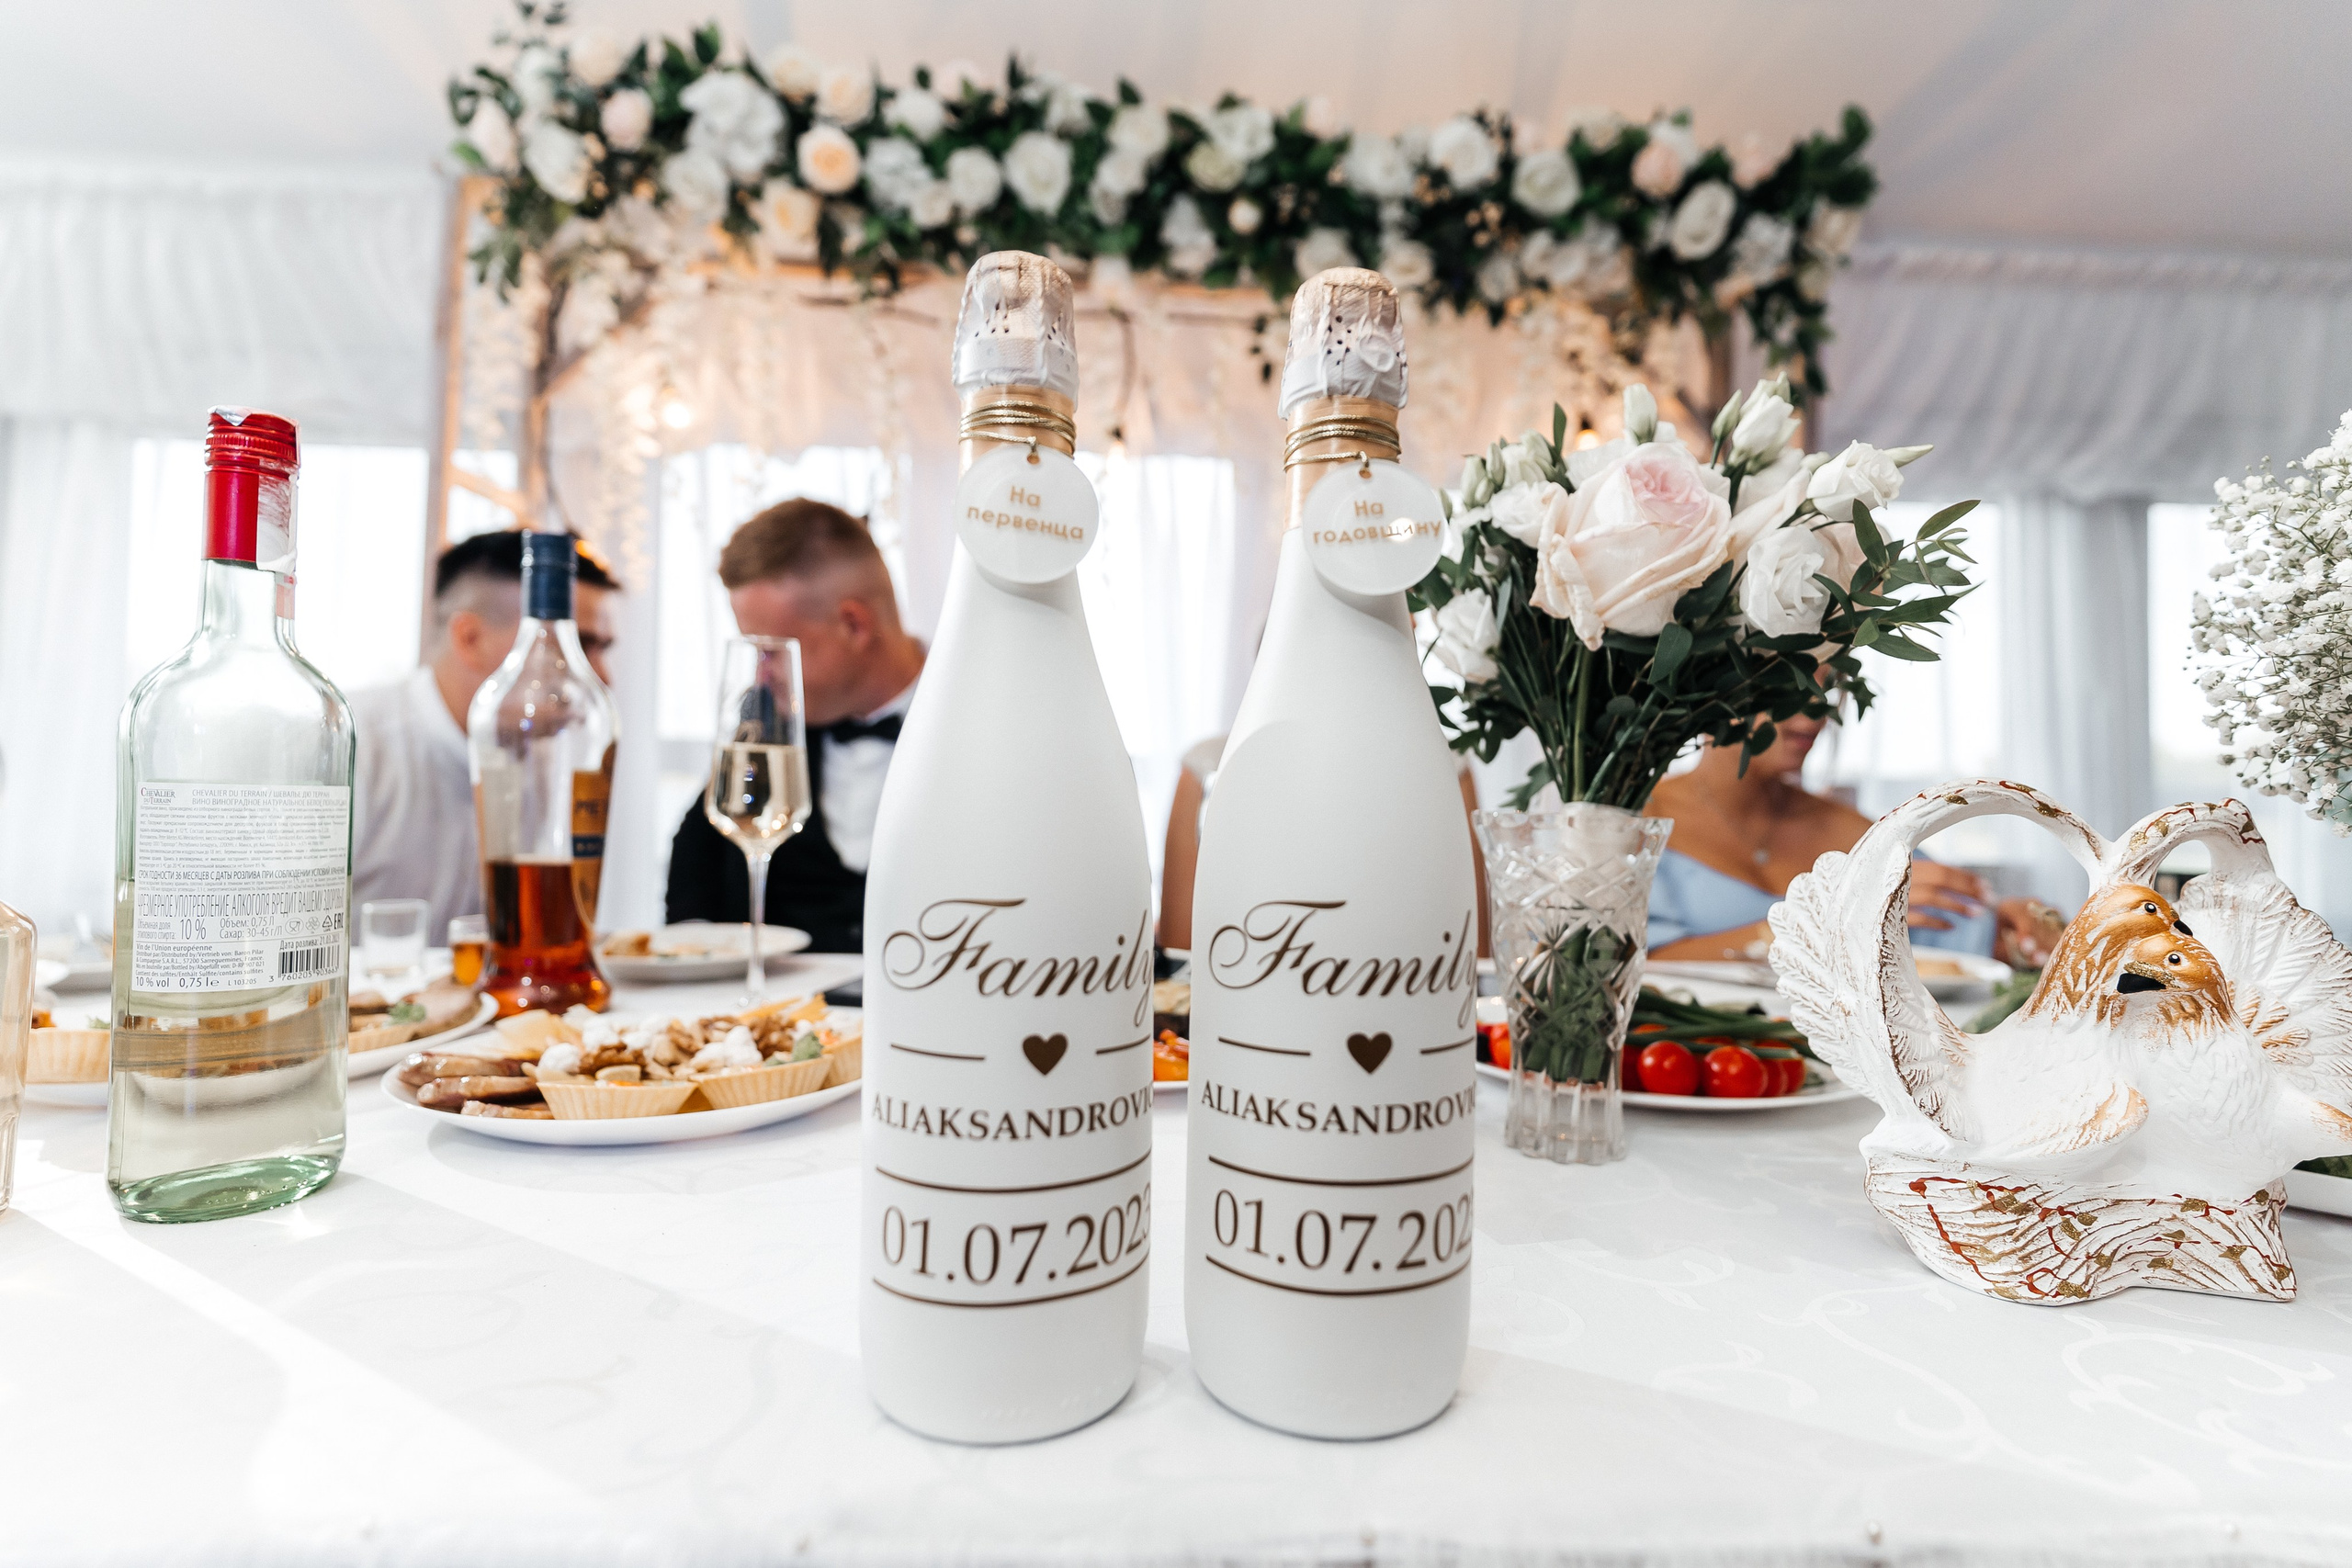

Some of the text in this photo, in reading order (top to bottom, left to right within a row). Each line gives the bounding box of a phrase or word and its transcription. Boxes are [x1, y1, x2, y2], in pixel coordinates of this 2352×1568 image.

[1010, 485, 1042, 507] На
[1354, 500, 1385, 517] На
[967, 505, 1085, 541] первенца
[1313, 520, 1443, 545] годовщину
[241, 790, 267, 798] TERRAIN
[212, 798, 261, 807] ВИНОГРАДНОЕ
[263, 798, 305, 807] НАТУРАЛЬНОЕ
[149, 870, 175, 880] ГОДНОСТИ
[175, 871, 182, 879] 36
[183, 871, 209, 881] МЕСЯЦЕВ
[210, 871, 215, 879] С
[216, 871, 232, 881] ДАТЫ
[233, 871, 261, 880] РОЗЛИВА
[262, 870, 274, 879] ПРИ
[275, 869, 311, 878] СОБЛЮДЕНИИ
[175, 894, 230, 918] УПОТРЕБЛЕНИЕ
[232, 894, 270, 917] АЛКОГОЛЯ
[272, 892, 298, 917] ВРЕДИТ
[299, 890, 322, 913] ВАШЕМУ
[180, 919, 207, 940] 10 %
[220, 918, 250, 929] Объем:
[251, 917, 267, 929] 0,75
[220, 930, 245, 940] Сахар:
[247, 928, 270, 938] 30-45
[173, 944, 213, 953] européenne
[279, 939, 295, 950] Дата
[295, 938, 319, 951] розлива:
[882, 897, 1153, 1028] Family
[1208, 899, 1476, 1029] Family
[136, 976, 144, 987] 10
[145, 976, 154, 987] %
[156, 976, 170, 987] vol
[179, 976, 202, 988] 0,75
[267, 976, 274, 985] 3
[282, 970, 313, 982] 760205
[1214, 1185, 1474, 1275] 01.07.202
